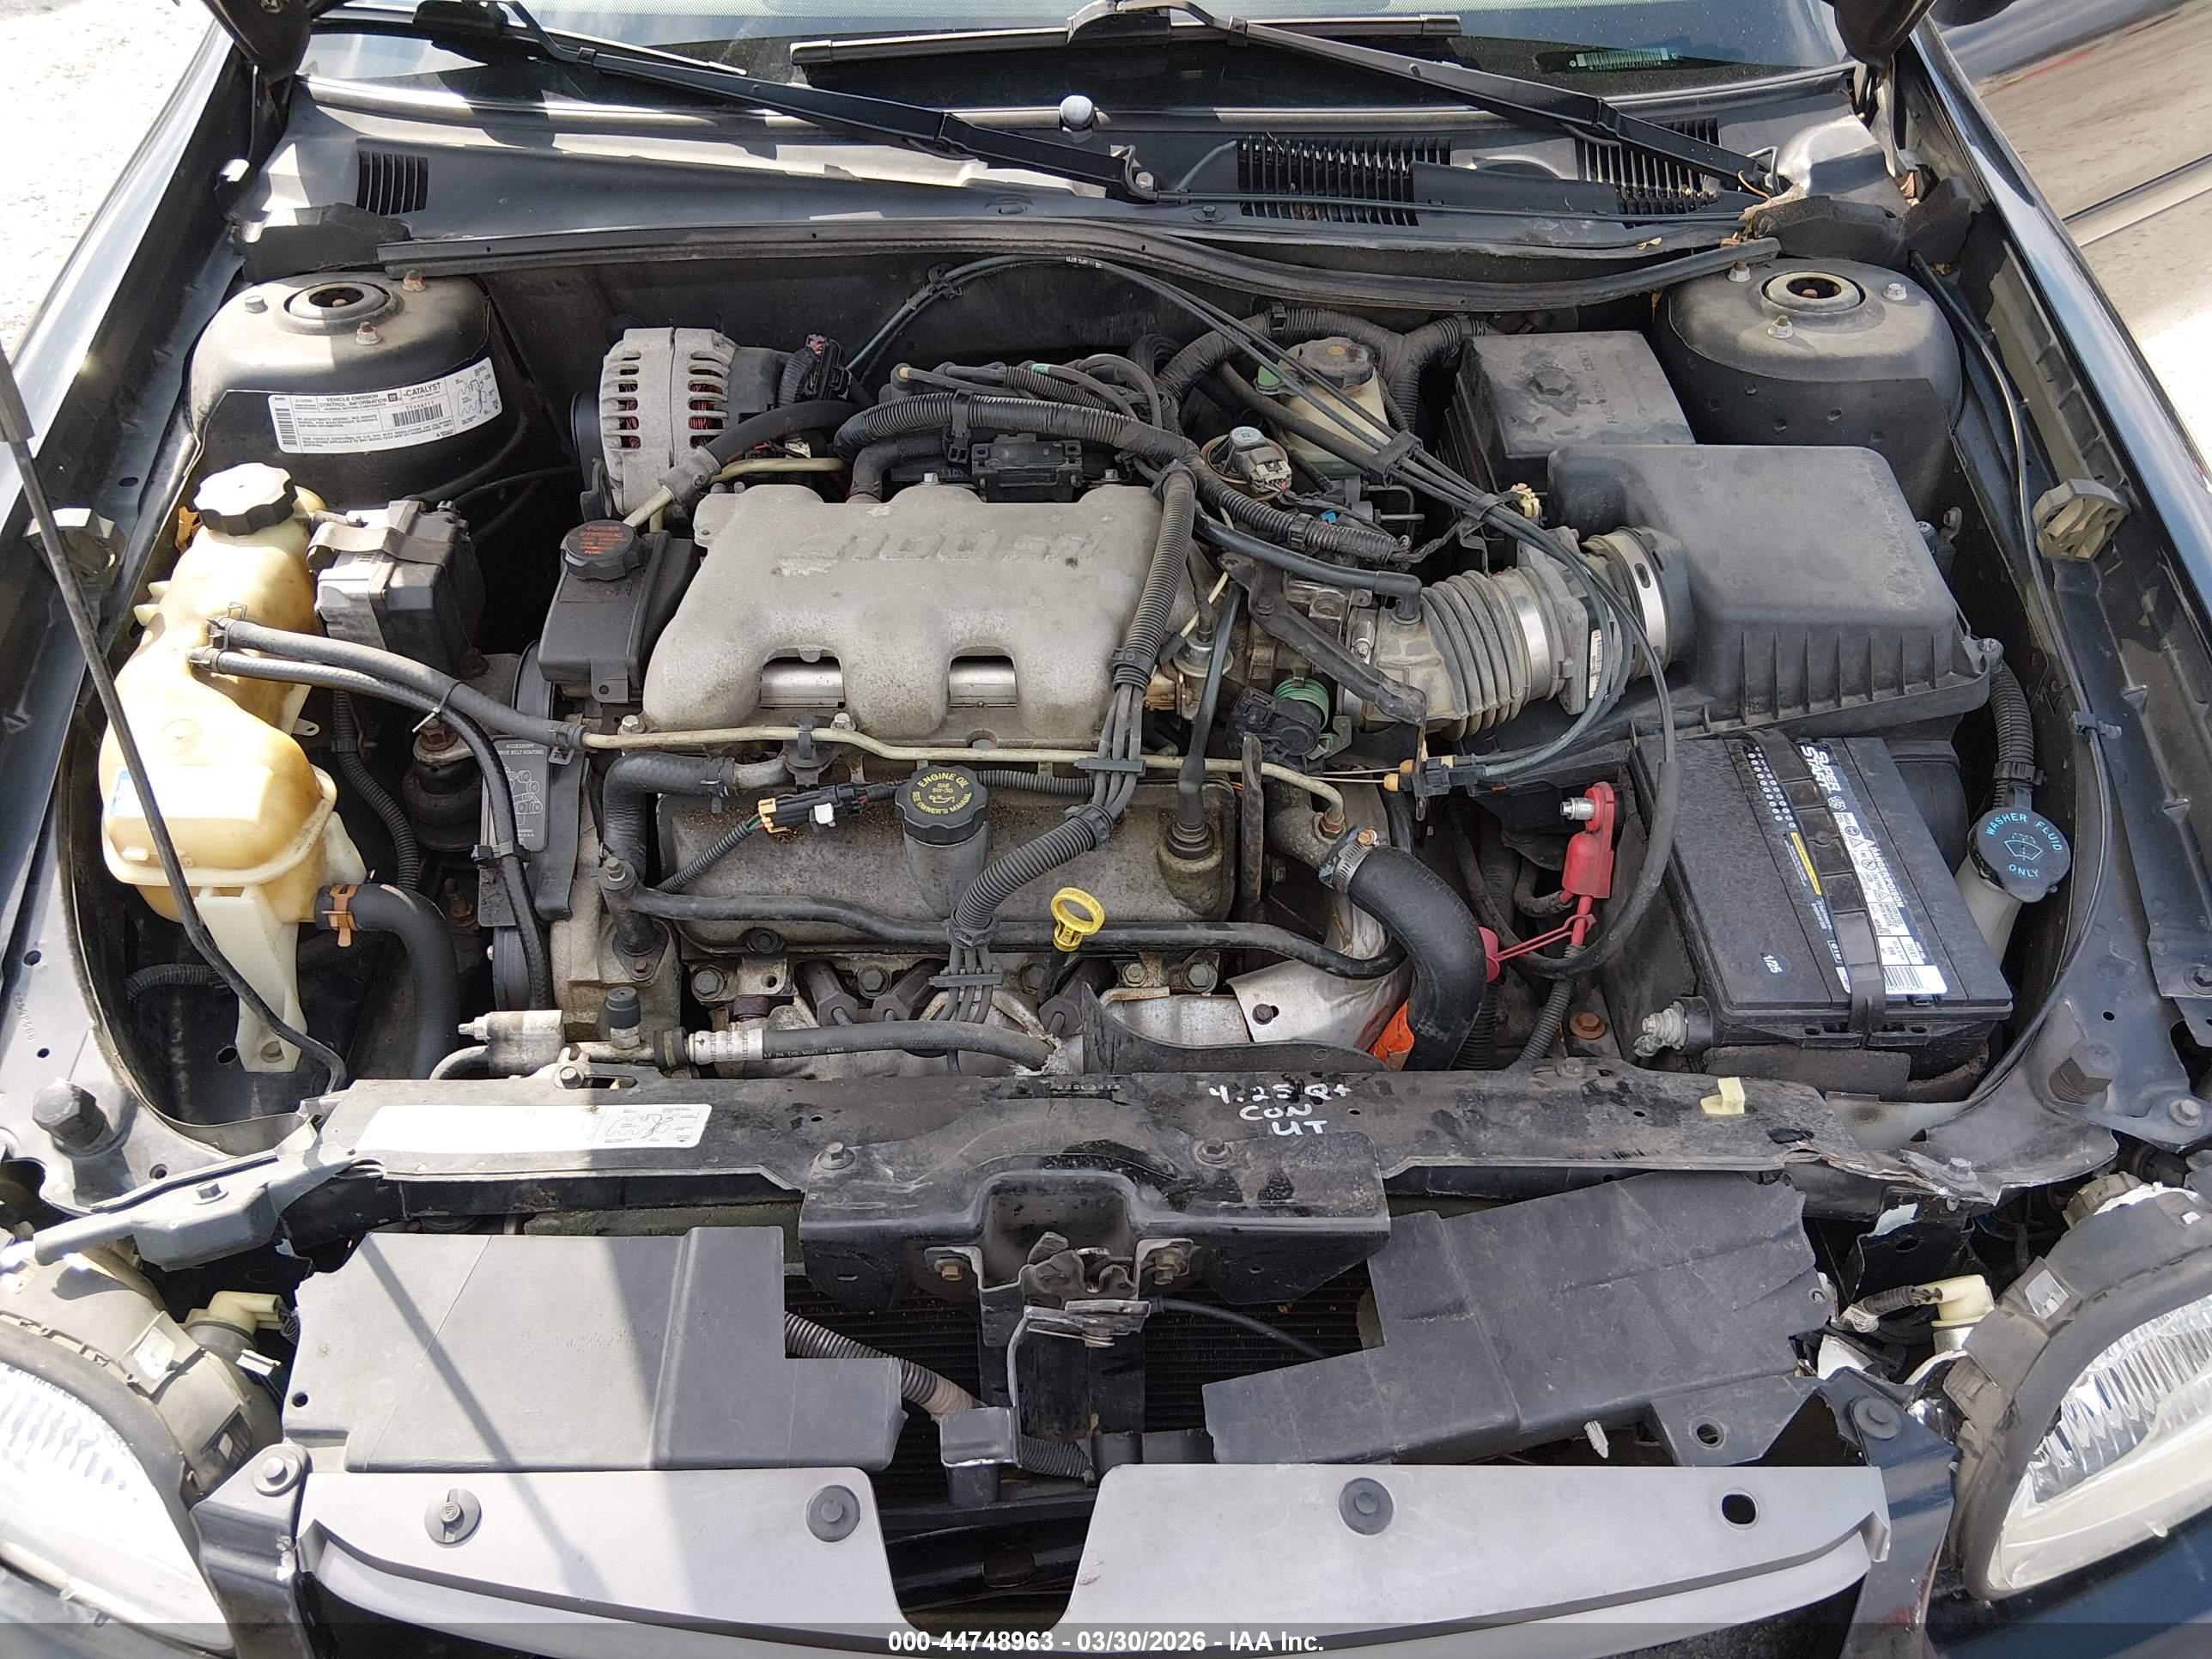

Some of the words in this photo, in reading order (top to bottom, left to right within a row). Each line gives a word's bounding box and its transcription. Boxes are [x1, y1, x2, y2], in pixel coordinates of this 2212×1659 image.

[1800, 745, 1831, 793] START
[1818, 750, 1842, 792] SUPER
[917, 773, 957, 787] ENGINE
[956, 776, 969, 789] OIL
[912, 791, 921, 803] SEE
[917, 802, 949, 814] OWNER'S
[949, 792, 972, 812] MANUAL
[1985, 812, 2027, 836] WASHER
[2035, 821, 2063, 851] FLUID
[2008, 864, 2039, 878] ONLY
[1763, 955, 1783, 973] 1/25
[1239, 1103, 1312, 1121] CON
